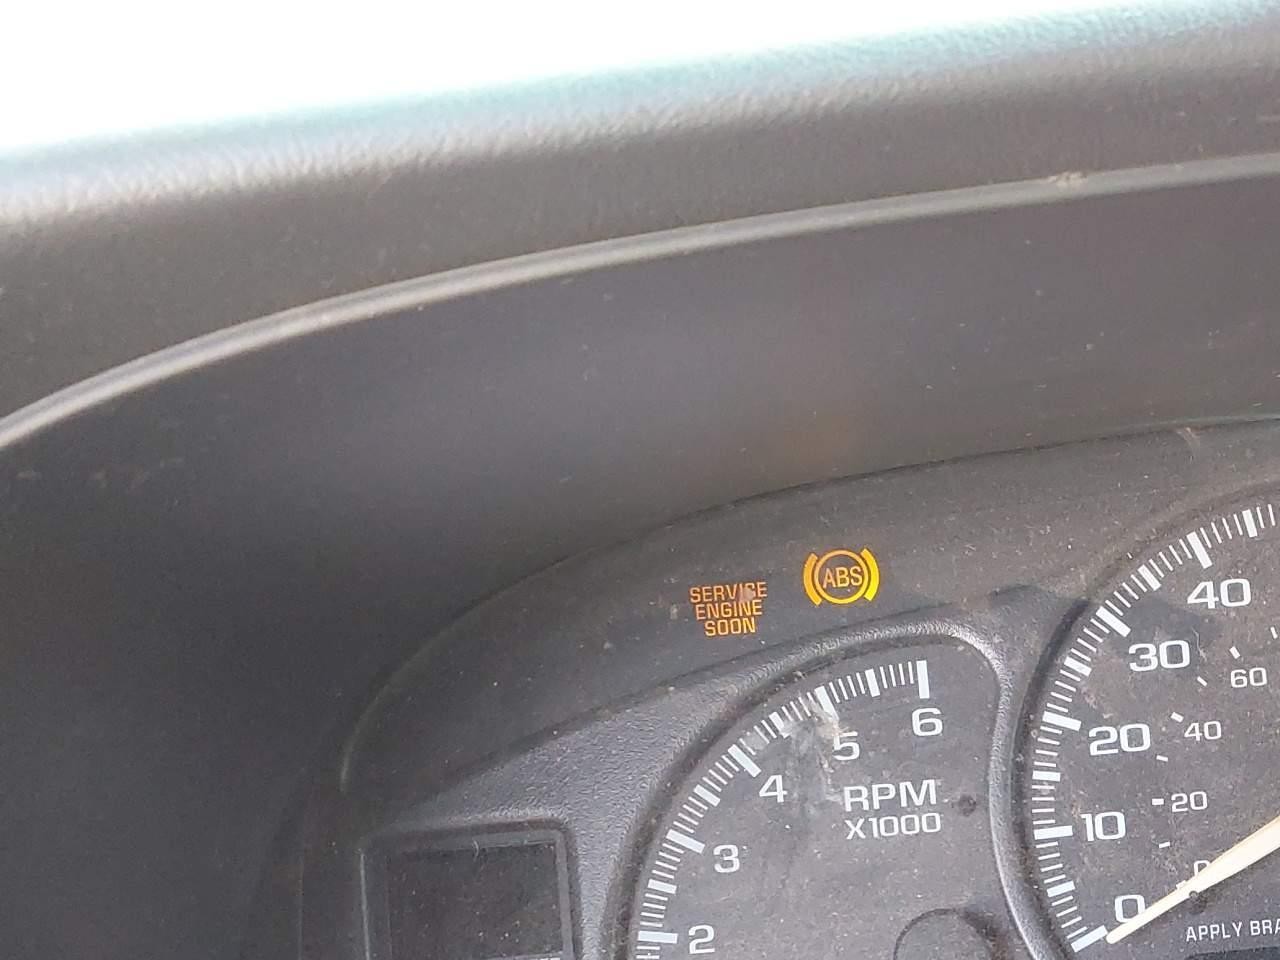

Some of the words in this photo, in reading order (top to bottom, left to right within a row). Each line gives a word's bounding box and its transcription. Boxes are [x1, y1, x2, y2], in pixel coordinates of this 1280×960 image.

[822, 565, 864, 589] ABS
[689, 581, 768, 603] SERVICE
[1187, 578, 1252, 609] 40
[695, 599, 763, 621] ENGINE
[704, 617, 756, 637] SOON
[1129, 640, 1191, 672] 30
[1230, 667, 1268, 688] 60
[911, 708, 943, 737] 6
[1184, 721, 1222, 742] 40
[833, 732, 860, 761] 5
[1088, 724, 1151, 755] 20
[759, 774, 788, 803] 4
[843, 779, 937, 813] RPM
[1170, 792, 1208, 813] 20
[844, 811, 942, 841] X1000
[1081, 812, 1126, 841] 10
[714, 844, 741, 873] 3
[1115, 894, 1146, 923] 0
[689, 926, 715, 954] 2
[1186, 921, 1243, 942] APPLY
